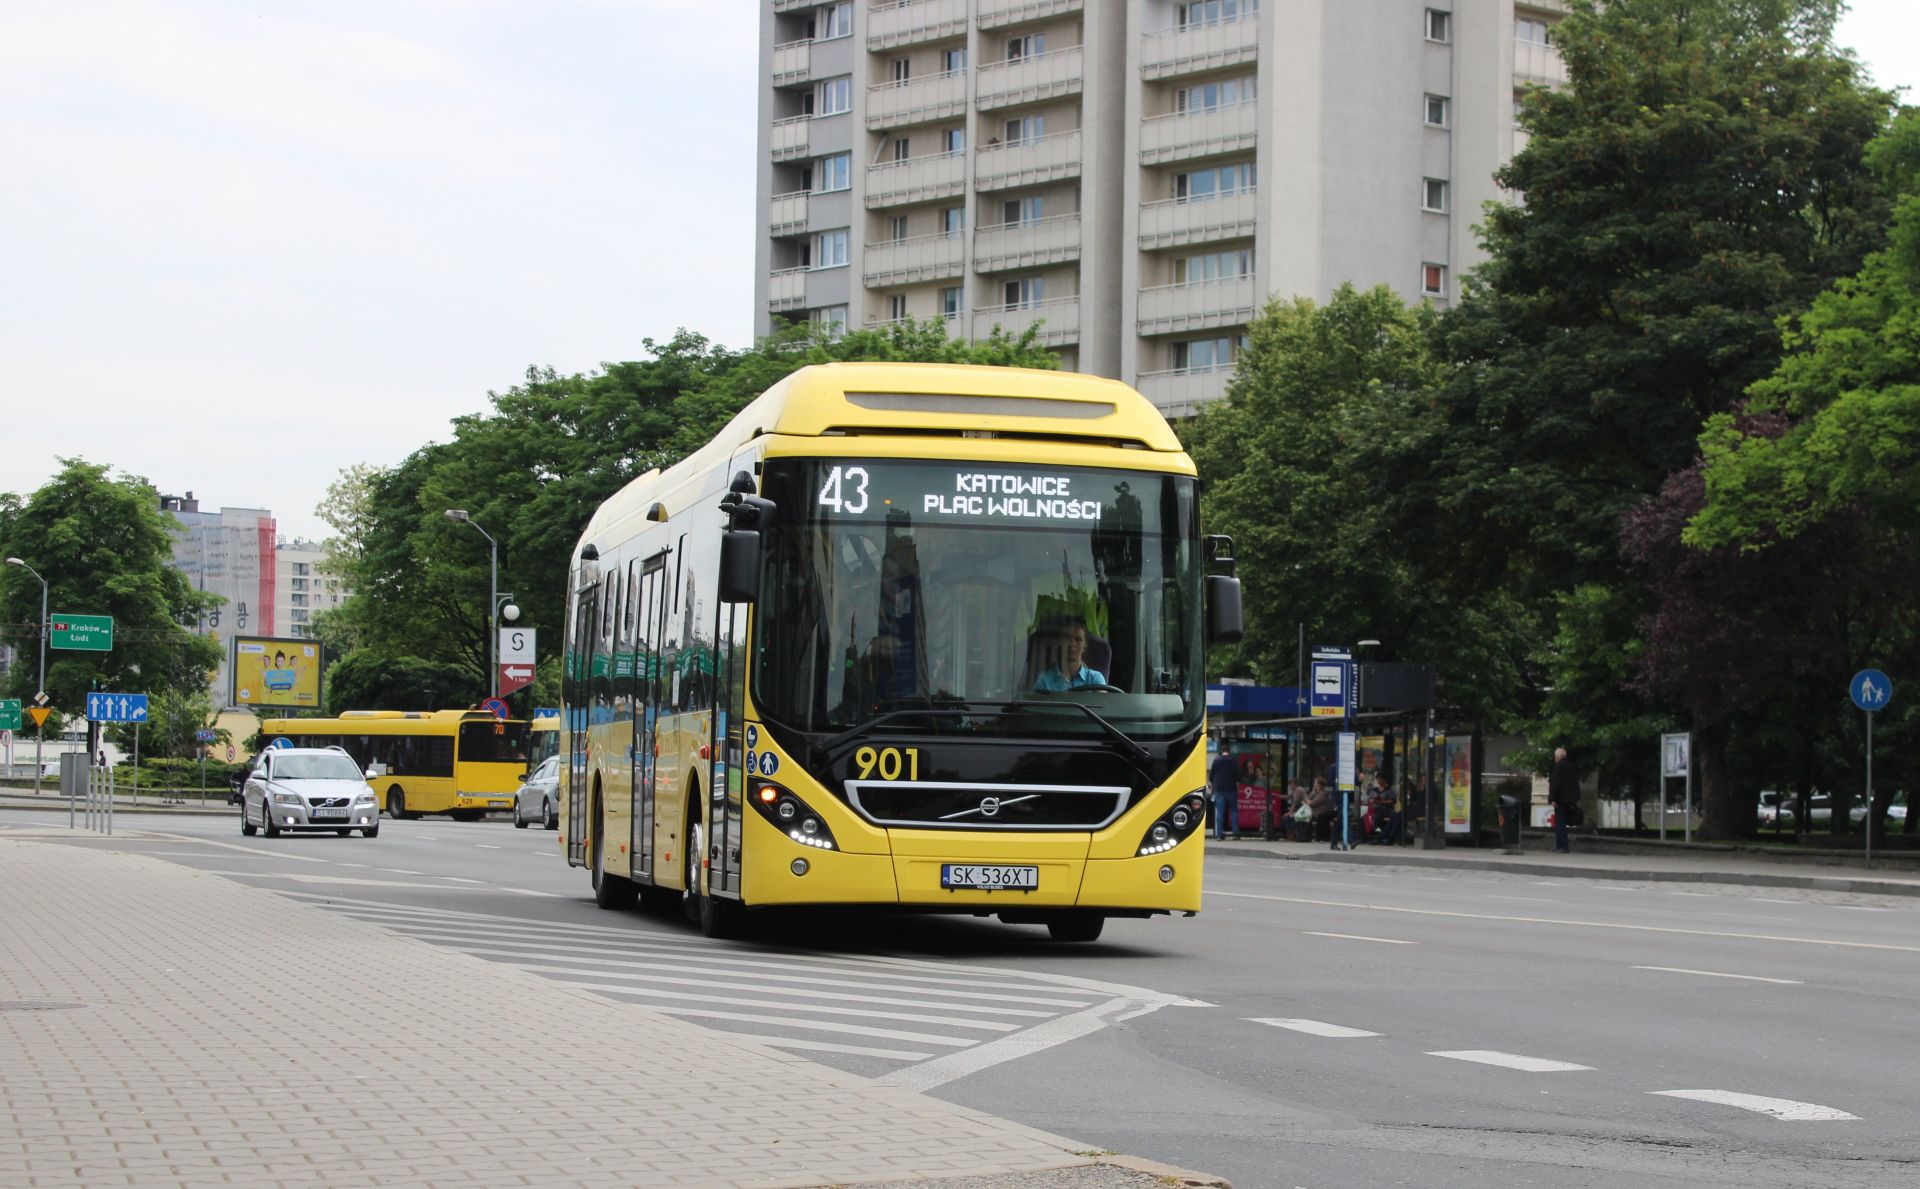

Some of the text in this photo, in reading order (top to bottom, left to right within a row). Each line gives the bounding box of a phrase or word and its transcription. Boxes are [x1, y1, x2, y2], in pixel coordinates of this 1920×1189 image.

[817, 466, 869, 515] 43
[956, 473, 1070, 496] KATOWICE
[923, 494, 1102, 520] PLAC WOLNOŚCI
[71, 623, 100, 632] Kraków
[70, 633, 89, 642] Łódź
[511, 632, 524, 651] S
[495, 724, 504, 735] 70
[855, 746, 918, 781] 901
[1244, 786, 1252, 799] 9
[953, 867, 1033, 885] SK 536XT
